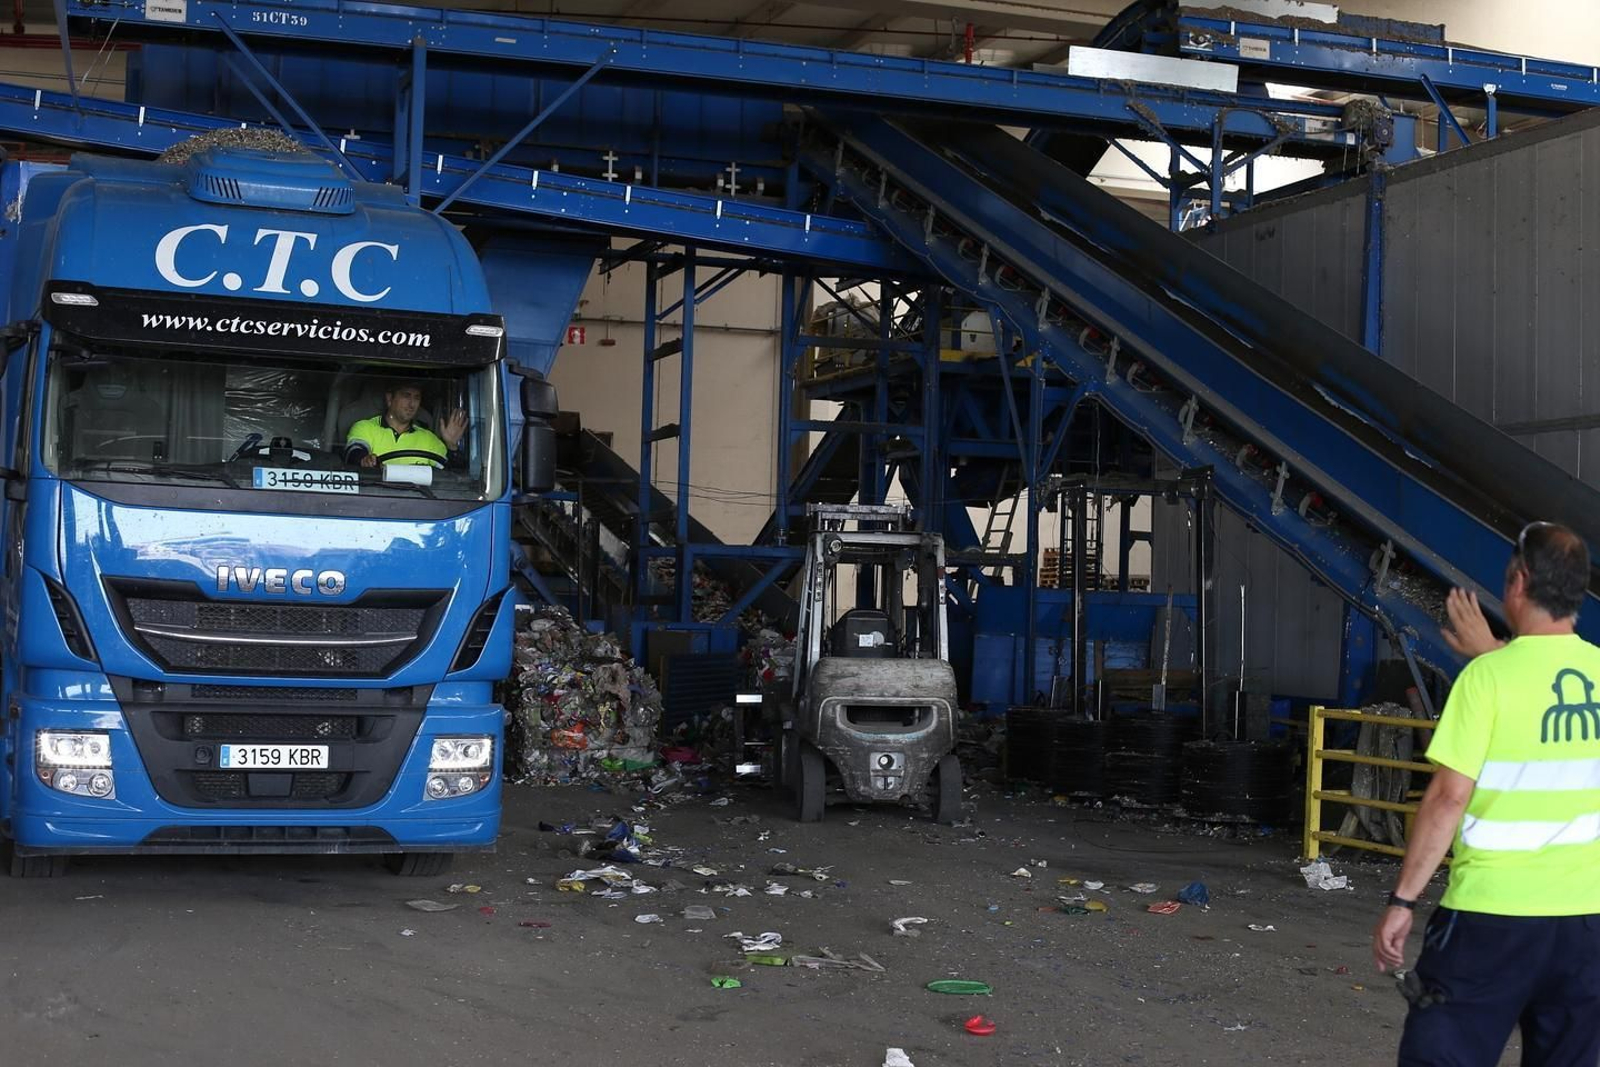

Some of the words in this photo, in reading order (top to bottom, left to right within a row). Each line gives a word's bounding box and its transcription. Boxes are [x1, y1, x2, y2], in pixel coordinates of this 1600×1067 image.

[155, 224, 399, 302] C.T.C
[142, 313, 431, 347] www.ctcservicios.com
[267, 471, 313, 488] 3159
[320, 474, 355, 490] KBR
[217, 566, 346, 595] IVECO
[238, 748, 281, 766] 3159
[288, 748, 321, 766] KBR
